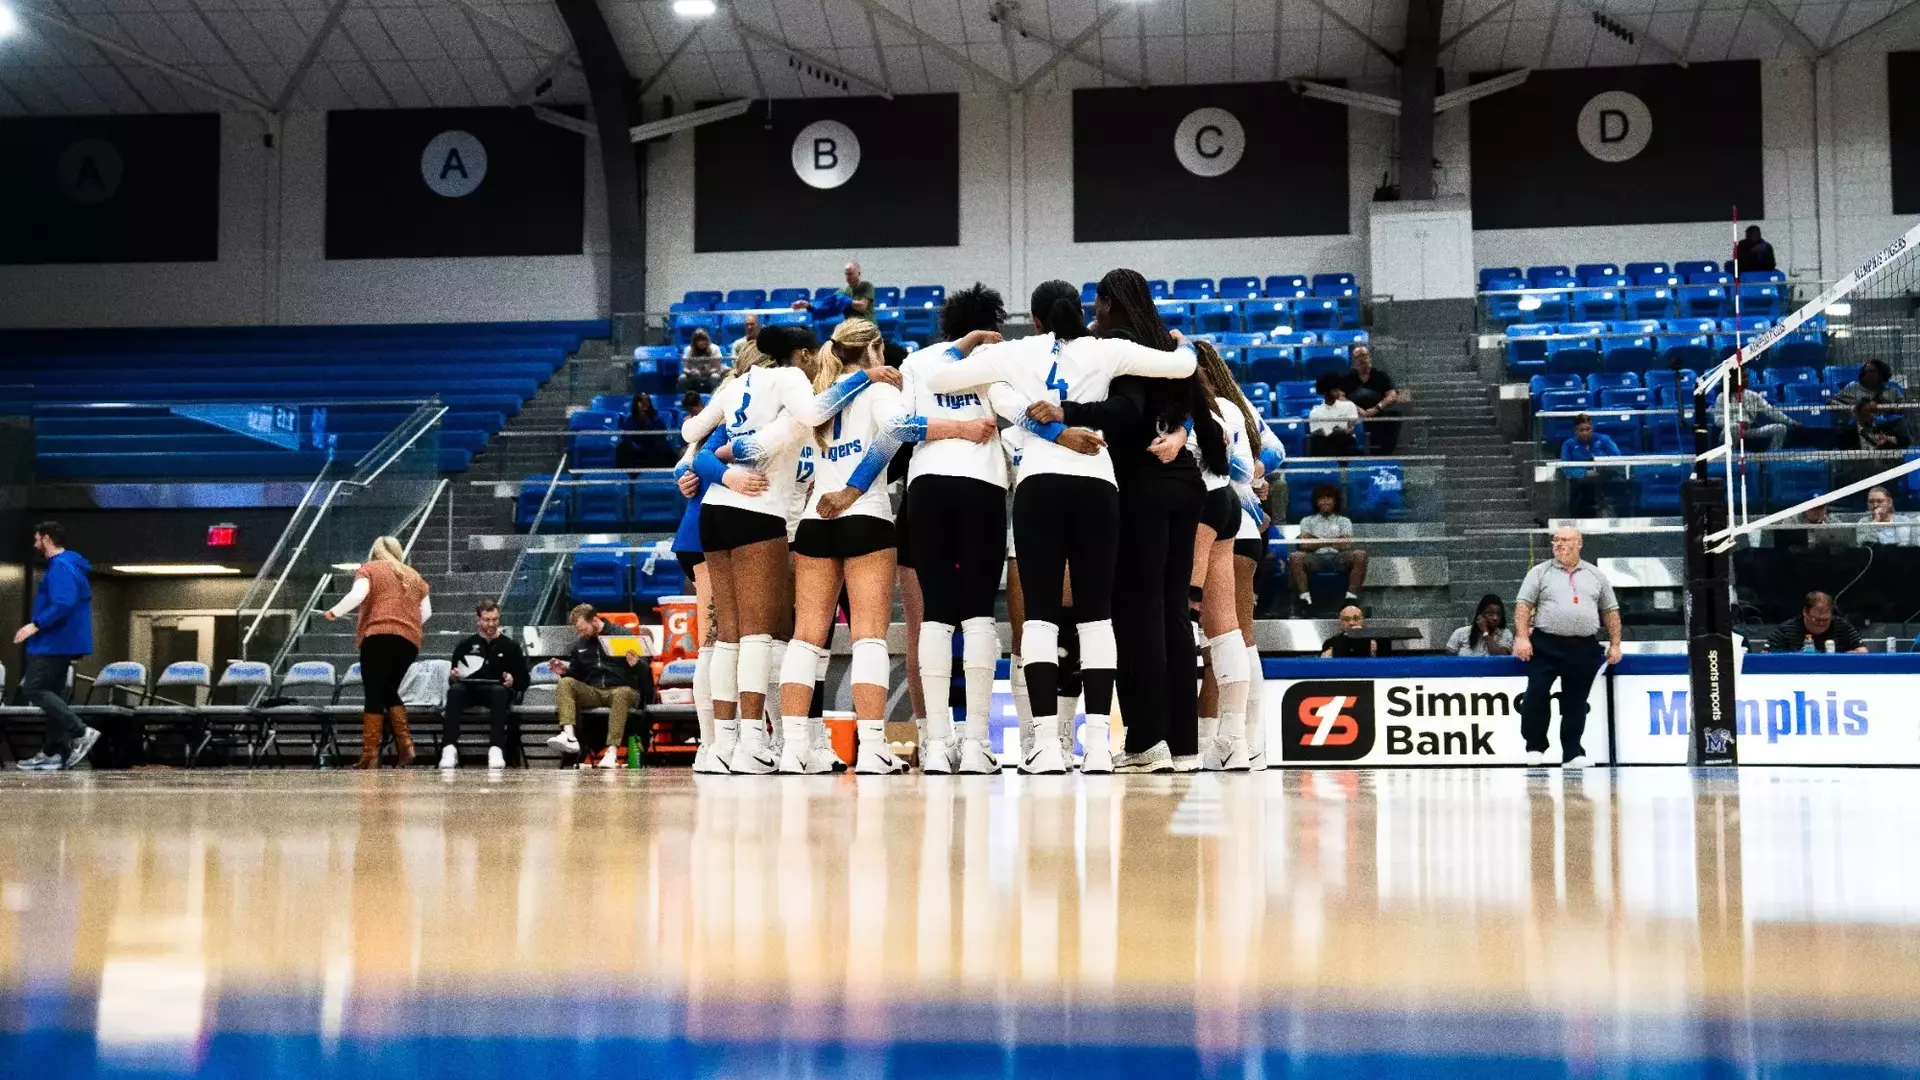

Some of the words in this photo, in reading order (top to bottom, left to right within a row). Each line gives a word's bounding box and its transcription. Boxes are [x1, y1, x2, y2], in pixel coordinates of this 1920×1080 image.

[1195, 125, 1224, 159] C
[1600, 109, 1629, 143] D
[439, 147, 469, 180] A
[813, 138, 839, 170] B
[1045, 361, 1069, 401] 4
[668, 612, 688, 635] G
[1708, 650, 1719, 681] sports
[1386, 684, 1591, 717] Simm
[1710, 682, 1722, 721] imports
[1646, 691, 1869, 744] Mmphis
[1386, 723, 1497, 756] Bank
